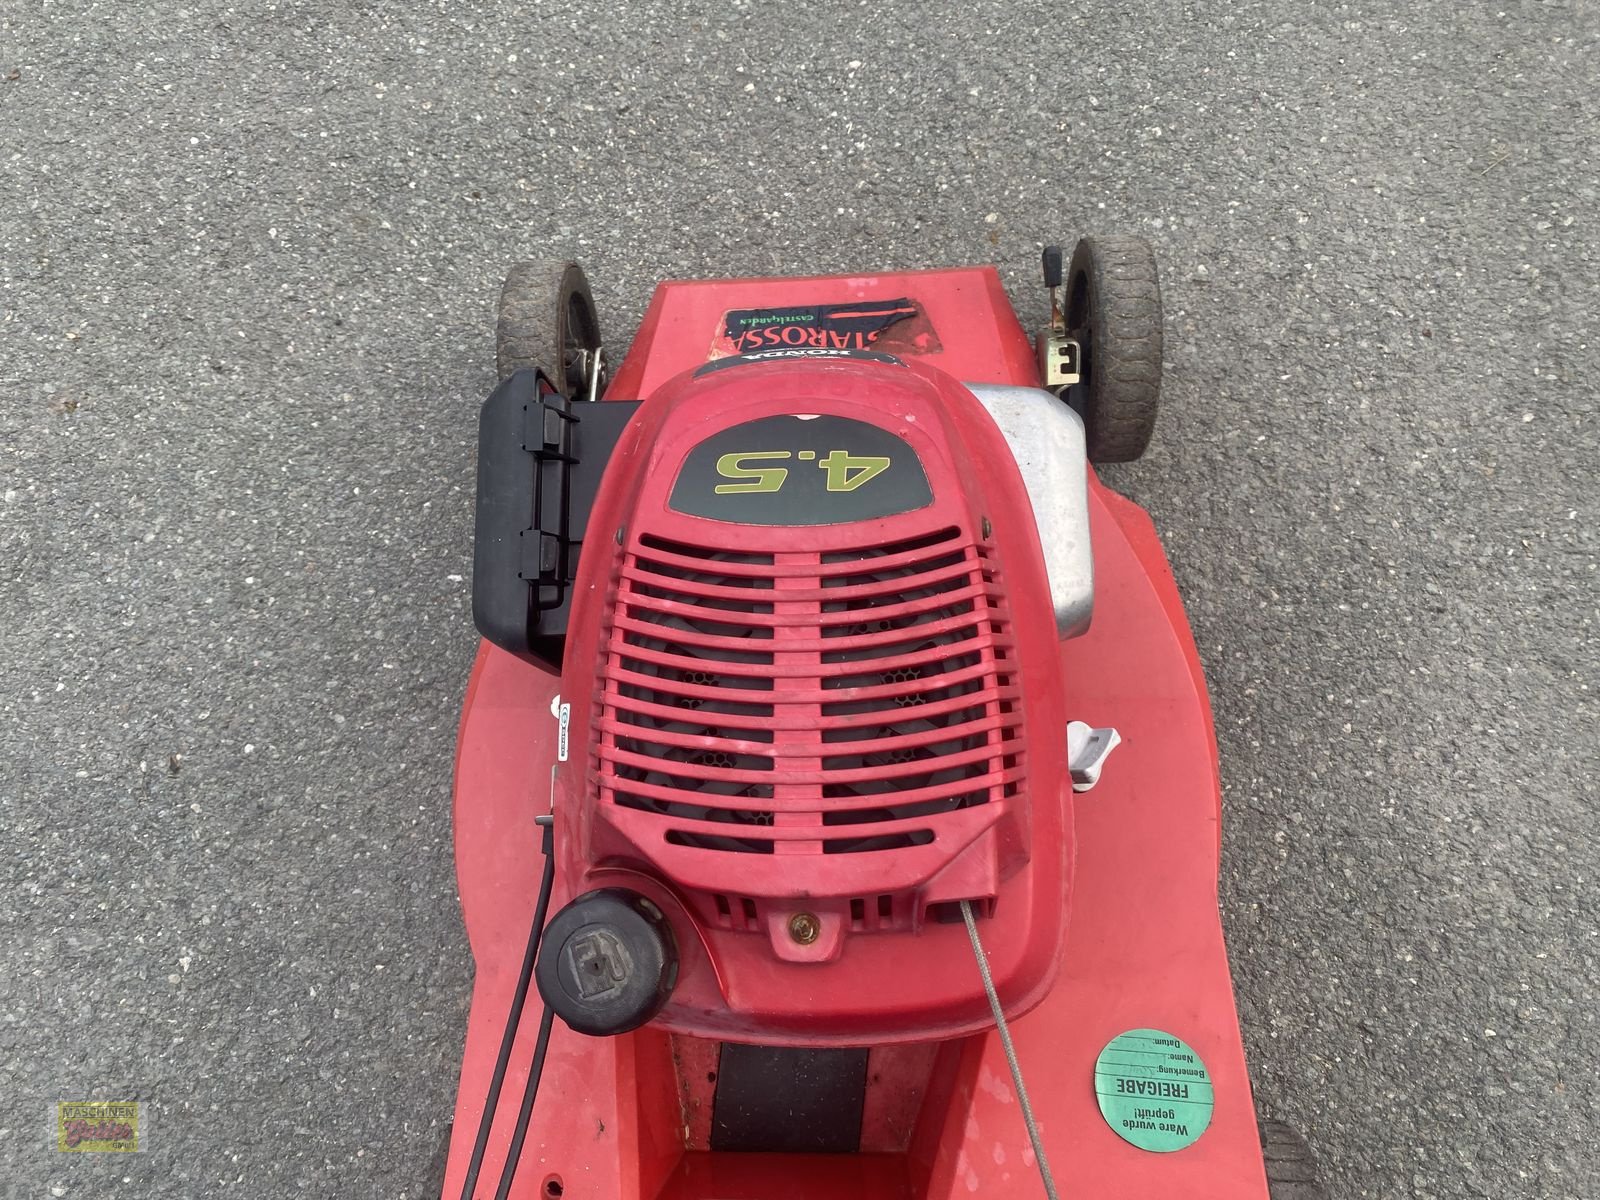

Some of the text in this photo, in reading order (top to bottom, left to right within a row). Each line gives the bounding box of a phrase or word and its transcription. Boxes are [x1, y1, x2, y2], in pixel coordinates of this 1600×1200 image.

[741, 349, 851, 360] HONDA
[715, 451, 890, 494] 4.5
[1153, 1038, 1181, 1049] Datum:
[1167, 1053, 1194, 1064] Name:
[1156, 1065, 1205, 1079] Bemerkung:
[1116, 1078, 1189, 1099] FREIGABE
[1134, 1108, 1175, 1120] geprüft!
[1123, 1119, 1189, 1136] Ware wurde
